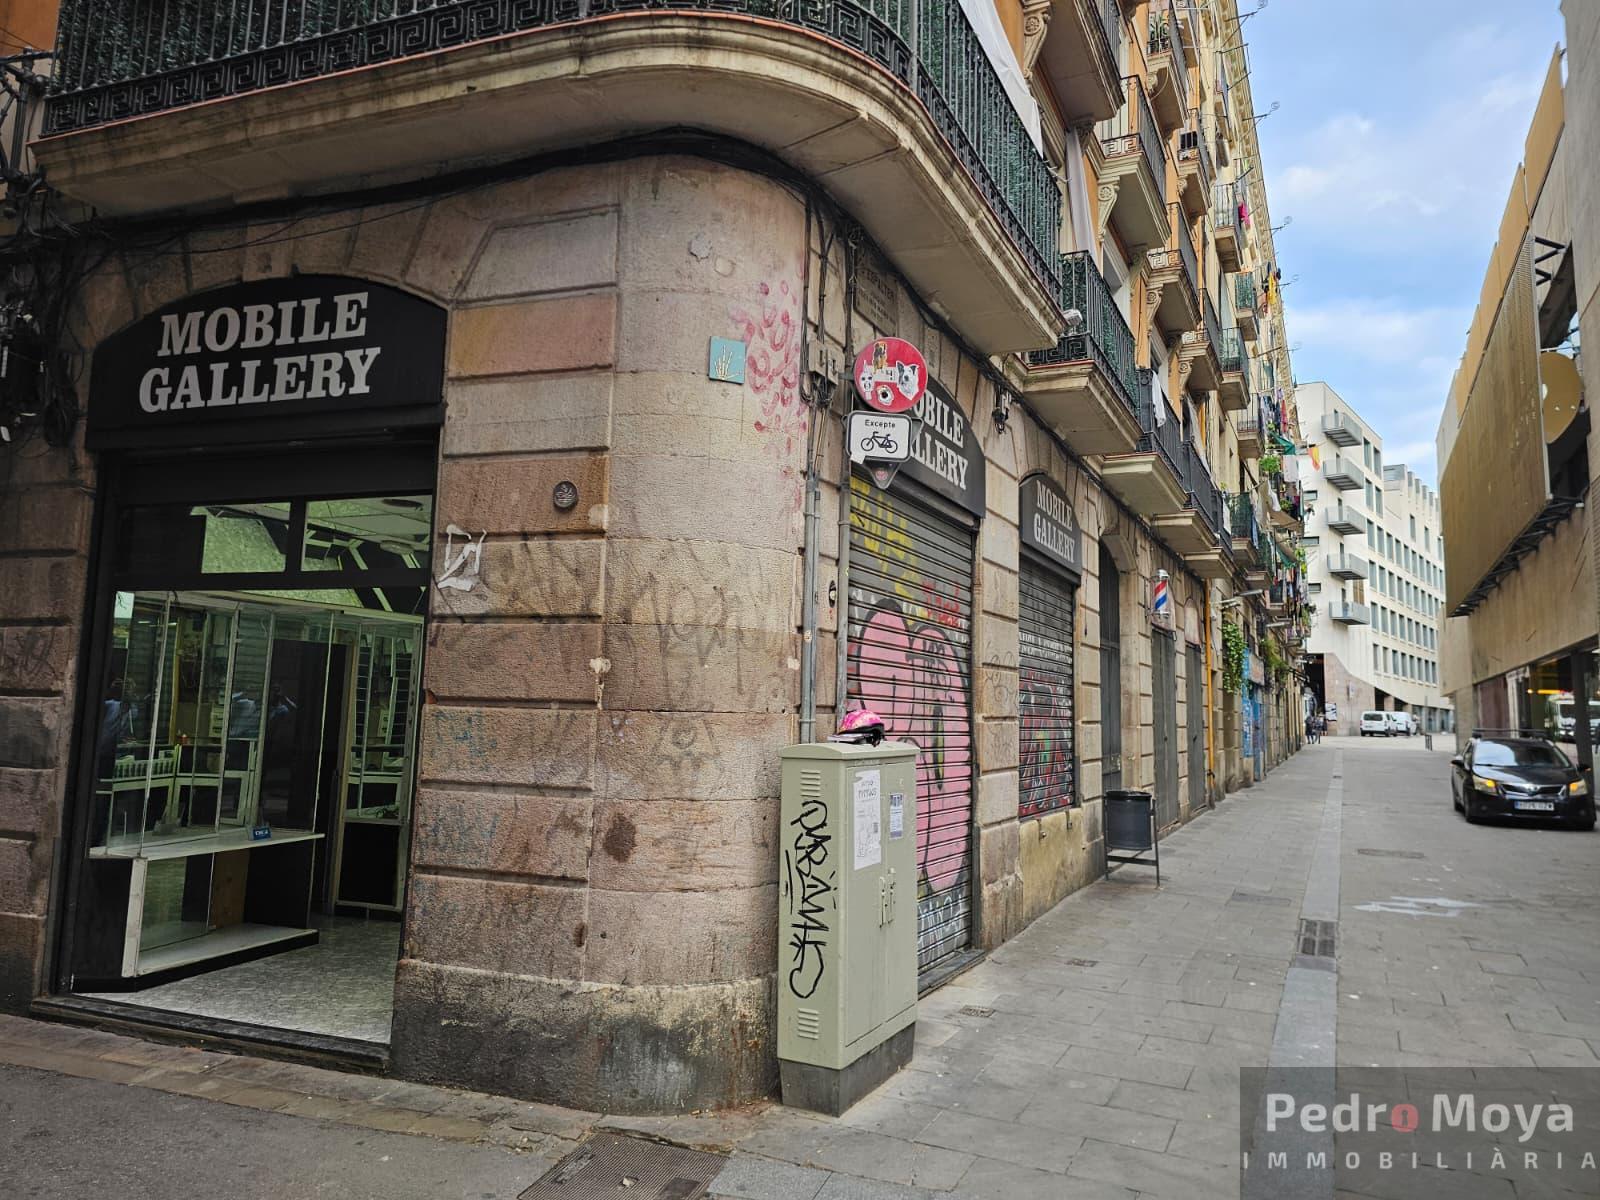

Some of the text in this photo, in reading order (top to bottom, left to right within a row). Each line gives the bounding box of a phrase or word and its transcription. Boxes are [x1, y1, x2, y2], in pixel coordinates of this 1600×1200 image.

[158, 292, 368, 356] MOBILE
[139, 347, 382, 412] GALLERY
[865, 419, 896, 429] Excepte
[911, 391, 963, 449] OBILE
[911, 432, 969, 490] LLERY
[1036, 480, 1073, 531] MOBILE
[1033, 512, 1075, 563] GALLERY
